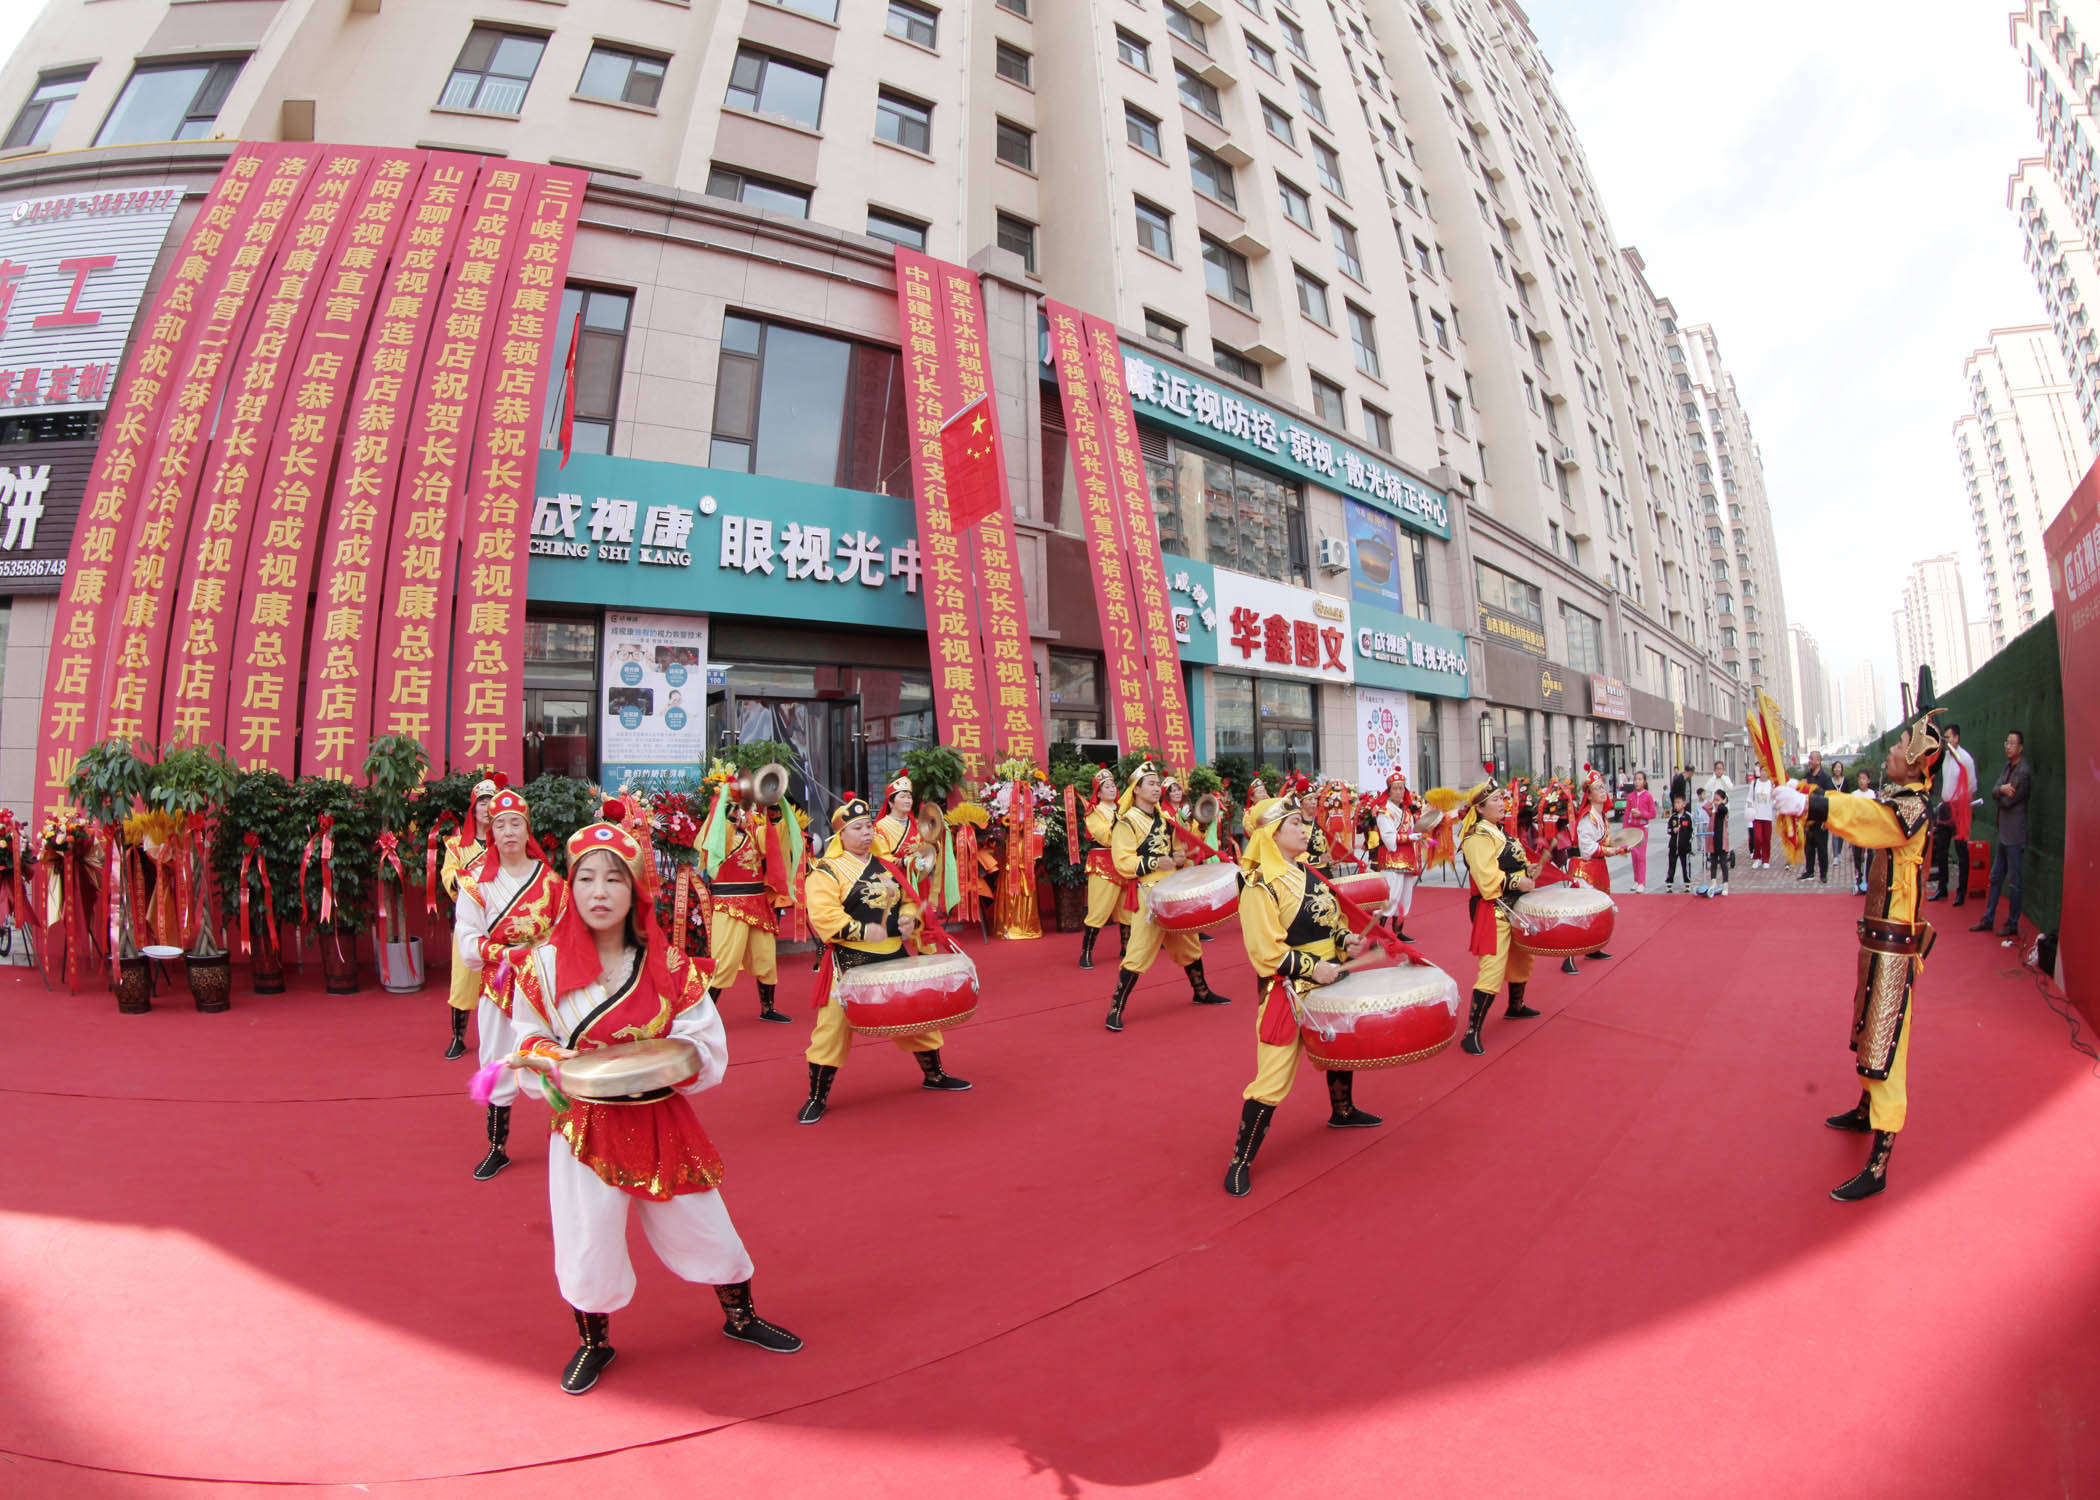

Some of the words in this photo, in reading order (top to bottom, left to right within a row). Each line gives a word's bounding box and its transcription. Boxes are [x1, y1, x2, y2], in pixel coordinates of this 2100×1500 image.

[30, 189, 174, 219] 0355-3557977
[463, 178, 573, 773] 三门峡成视康连锁店恭祝长治成视康总店开
[598, 544, 630, 562] SHI
[639, 548, 692, 567] KANG
[1229, 605, 1347, 672] 华鑫图文
[1411, 640, 1468, 677] 眼视光中心
